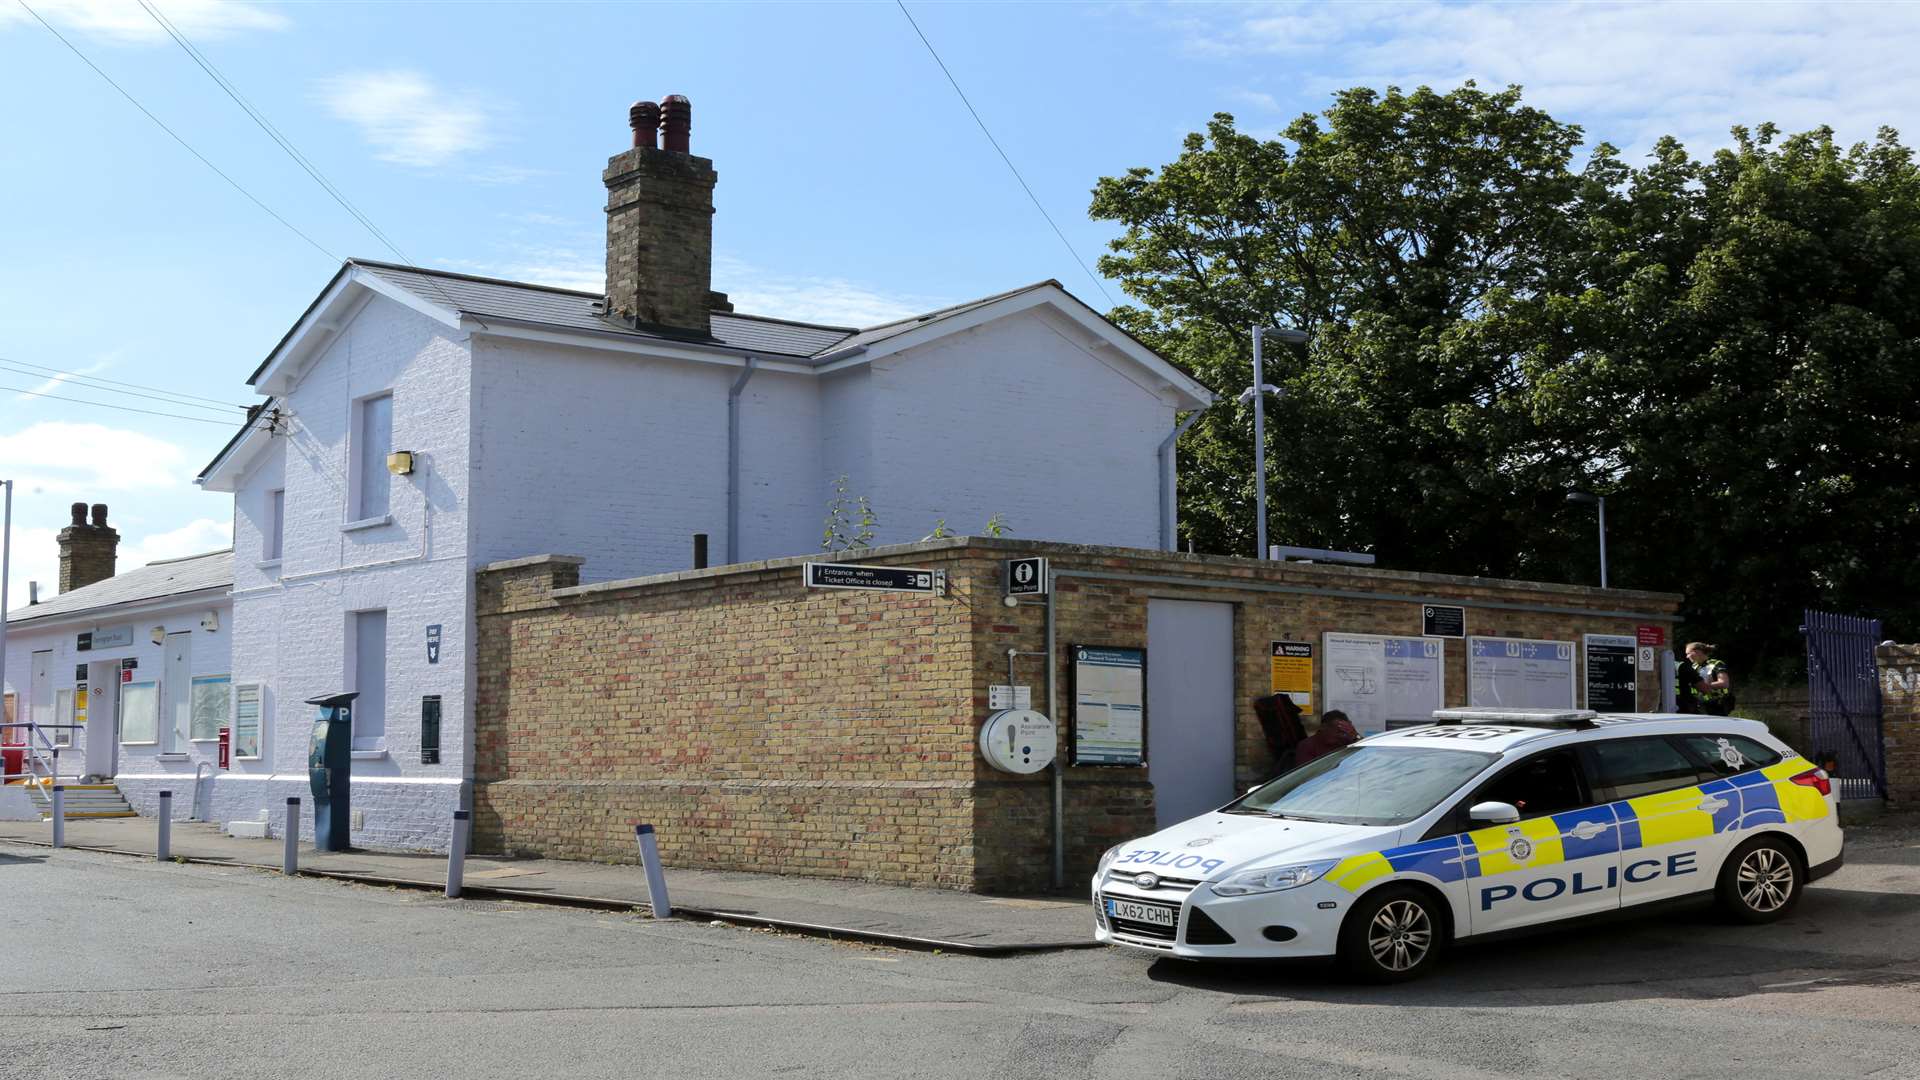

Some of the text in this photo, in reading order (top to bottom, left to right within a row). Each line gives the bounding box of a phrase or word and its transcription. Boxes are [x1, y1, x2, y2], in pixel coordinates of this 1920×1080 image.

[824, 568, 853, 576] Entrance
[845, 577, 865, 585] Office
[339, 707, 349, 720] P
[1481, 851, 1698, 911] POLICE
[1114, 900, 1171, 924] LX62 CHH
